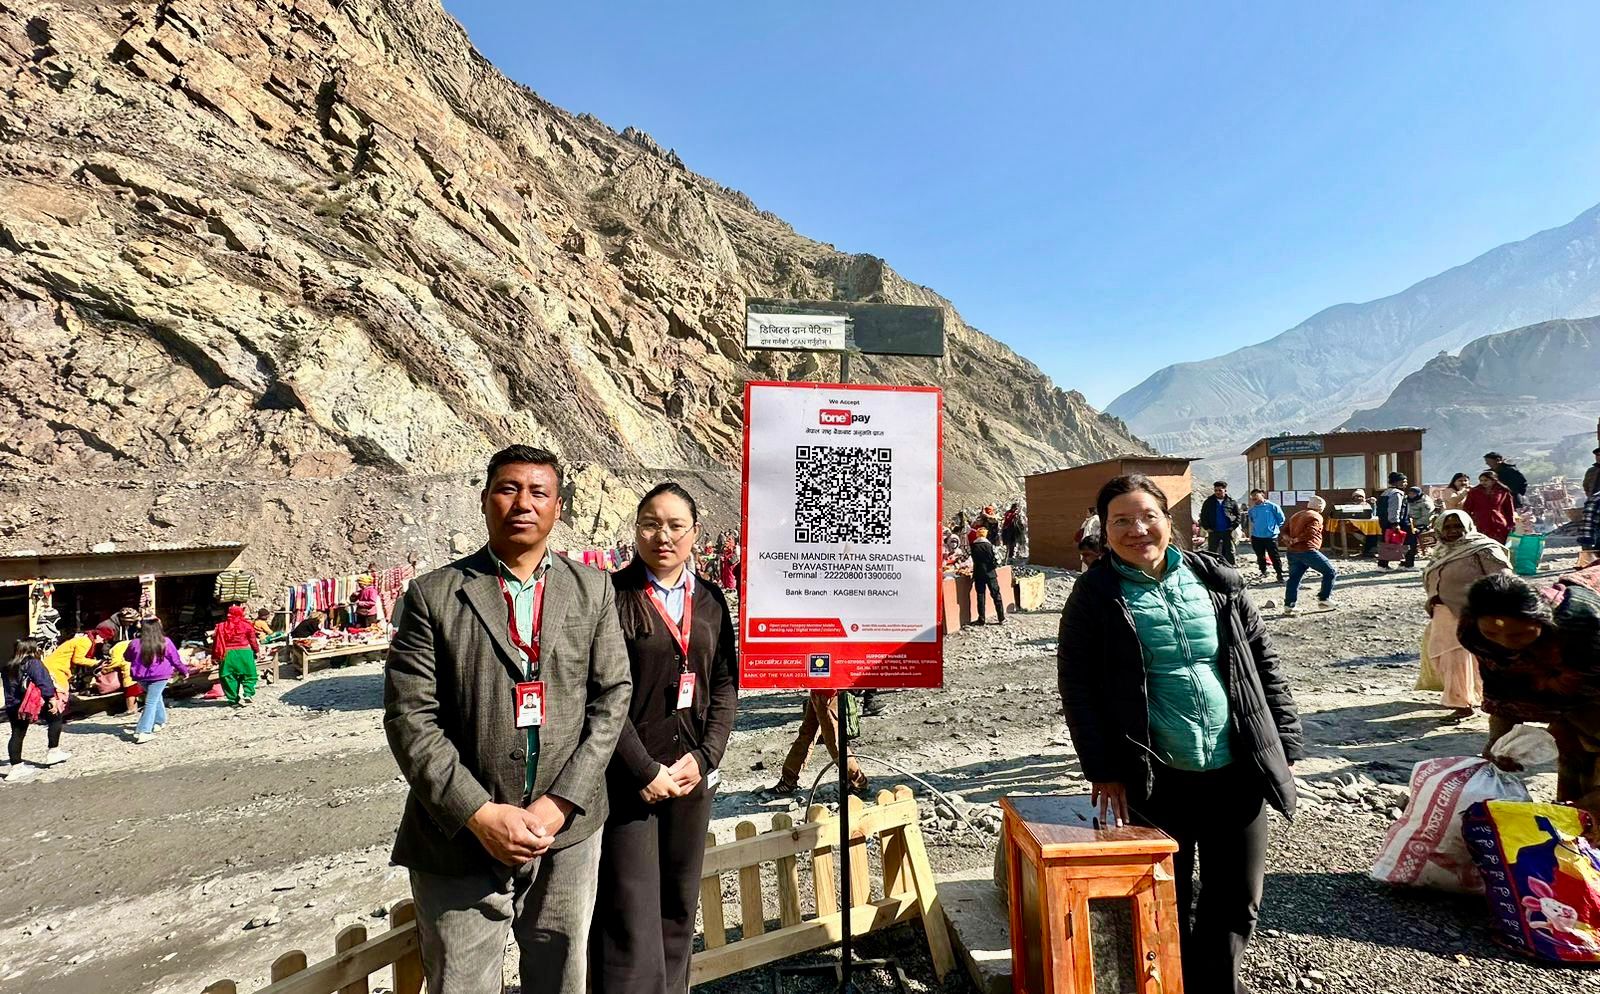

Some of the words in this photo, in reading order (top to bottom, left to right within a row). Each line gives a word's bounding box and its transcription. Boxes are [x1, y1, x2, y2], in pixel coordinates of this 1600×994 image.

[760, 324, 790, 335] डिजिटल
[792, 326, 806, 335] दान
[808, 324, 832, 335] पेटिका
[759, 552, 799, 560] KAGBENI
[801, 552, 836, 561] MANDIR
[838, 553, 867, 561] TATHA
[869, 553, 926, 563] SRADASTHAL
[792, 562, 863, 571] BYAVASTHAPAN
[865, 563, 894, 572] SAMITI
[783, 571, 818, 579] Terminal
[824, 571, 902, 580] 2222080013900600
[833, 589, 866, 597] KAGBENI
[867, 589, 899, 597] BRANCH
